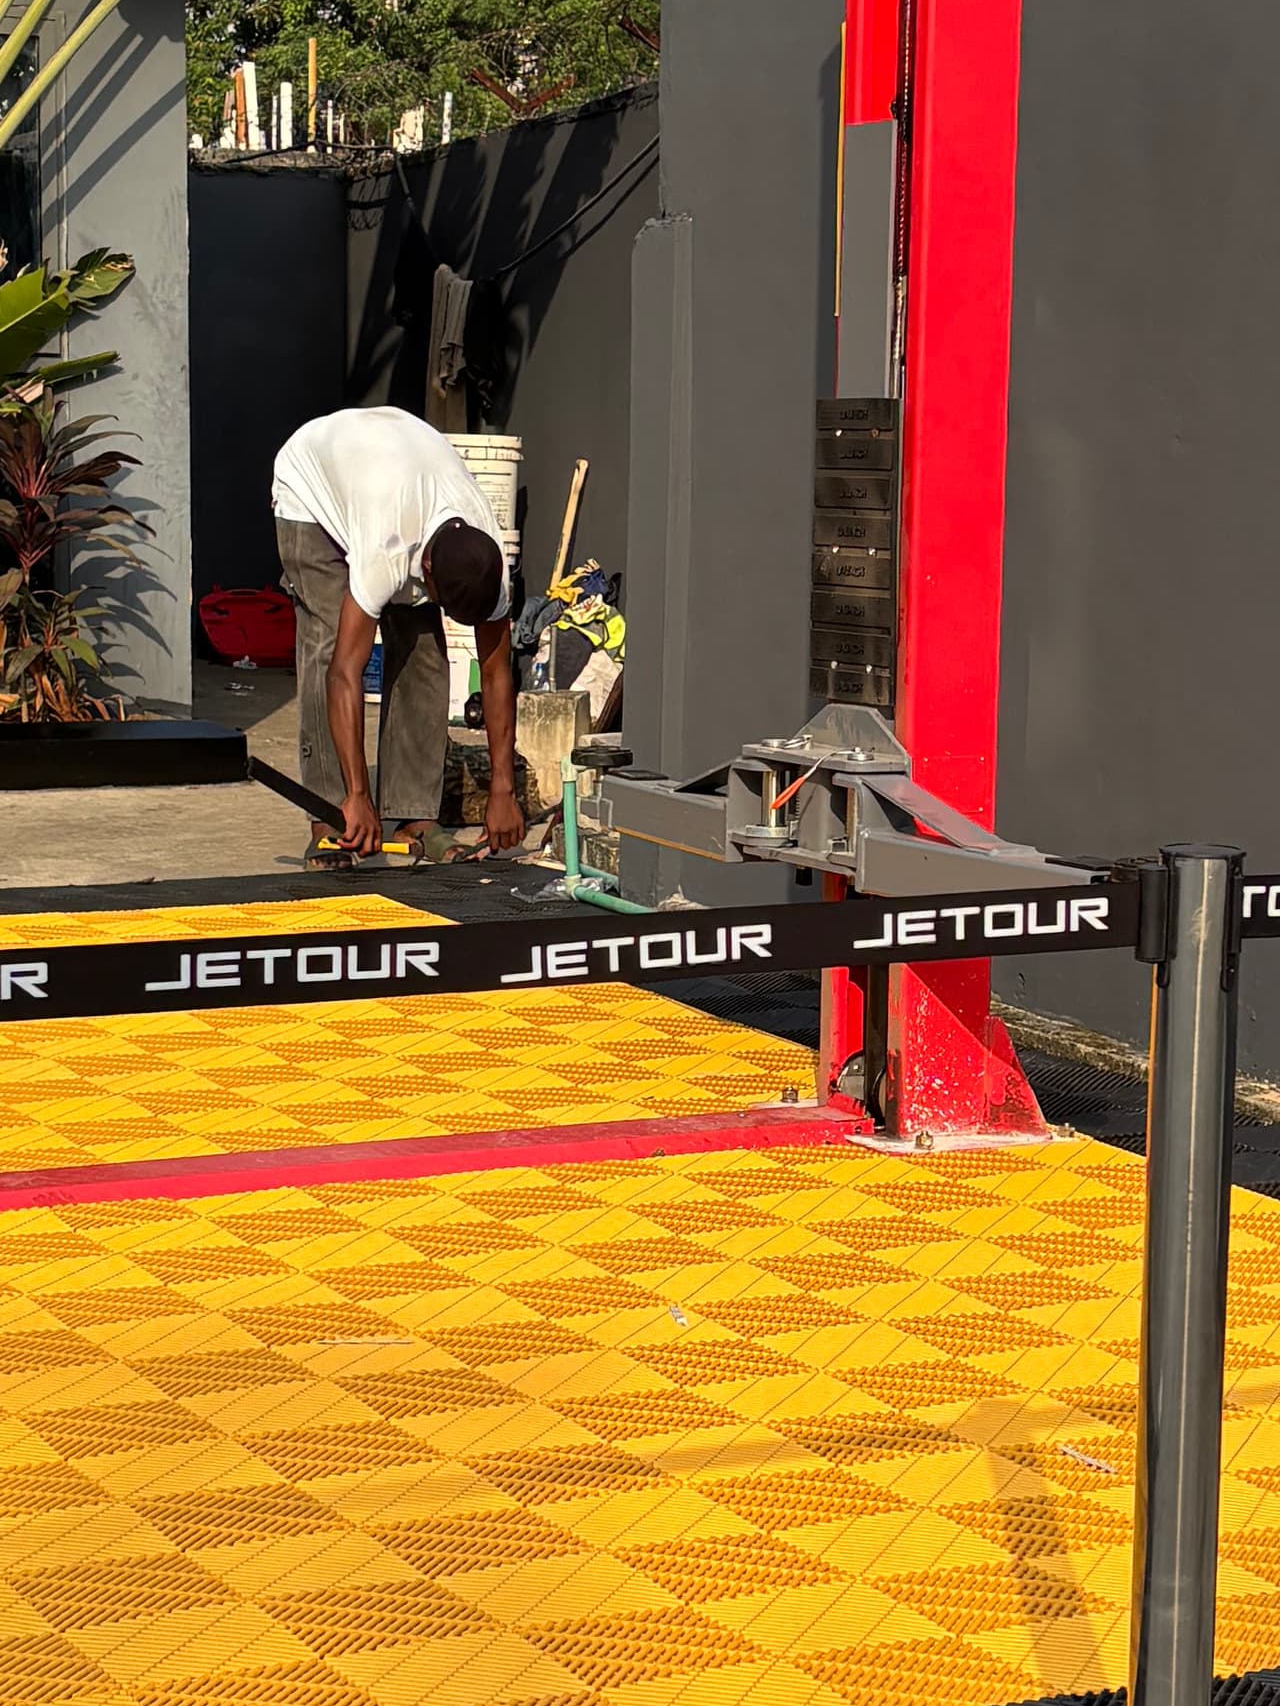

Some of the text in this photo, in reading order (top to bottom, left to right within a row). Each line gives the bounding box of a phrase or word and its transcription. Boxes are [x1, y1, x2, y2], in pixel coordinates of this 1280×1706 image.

[145, 941, 441, 992] JETOUR
[501, 923, 773, 984] JETOUR
[853, 889, 1109, 949] JETOUR
